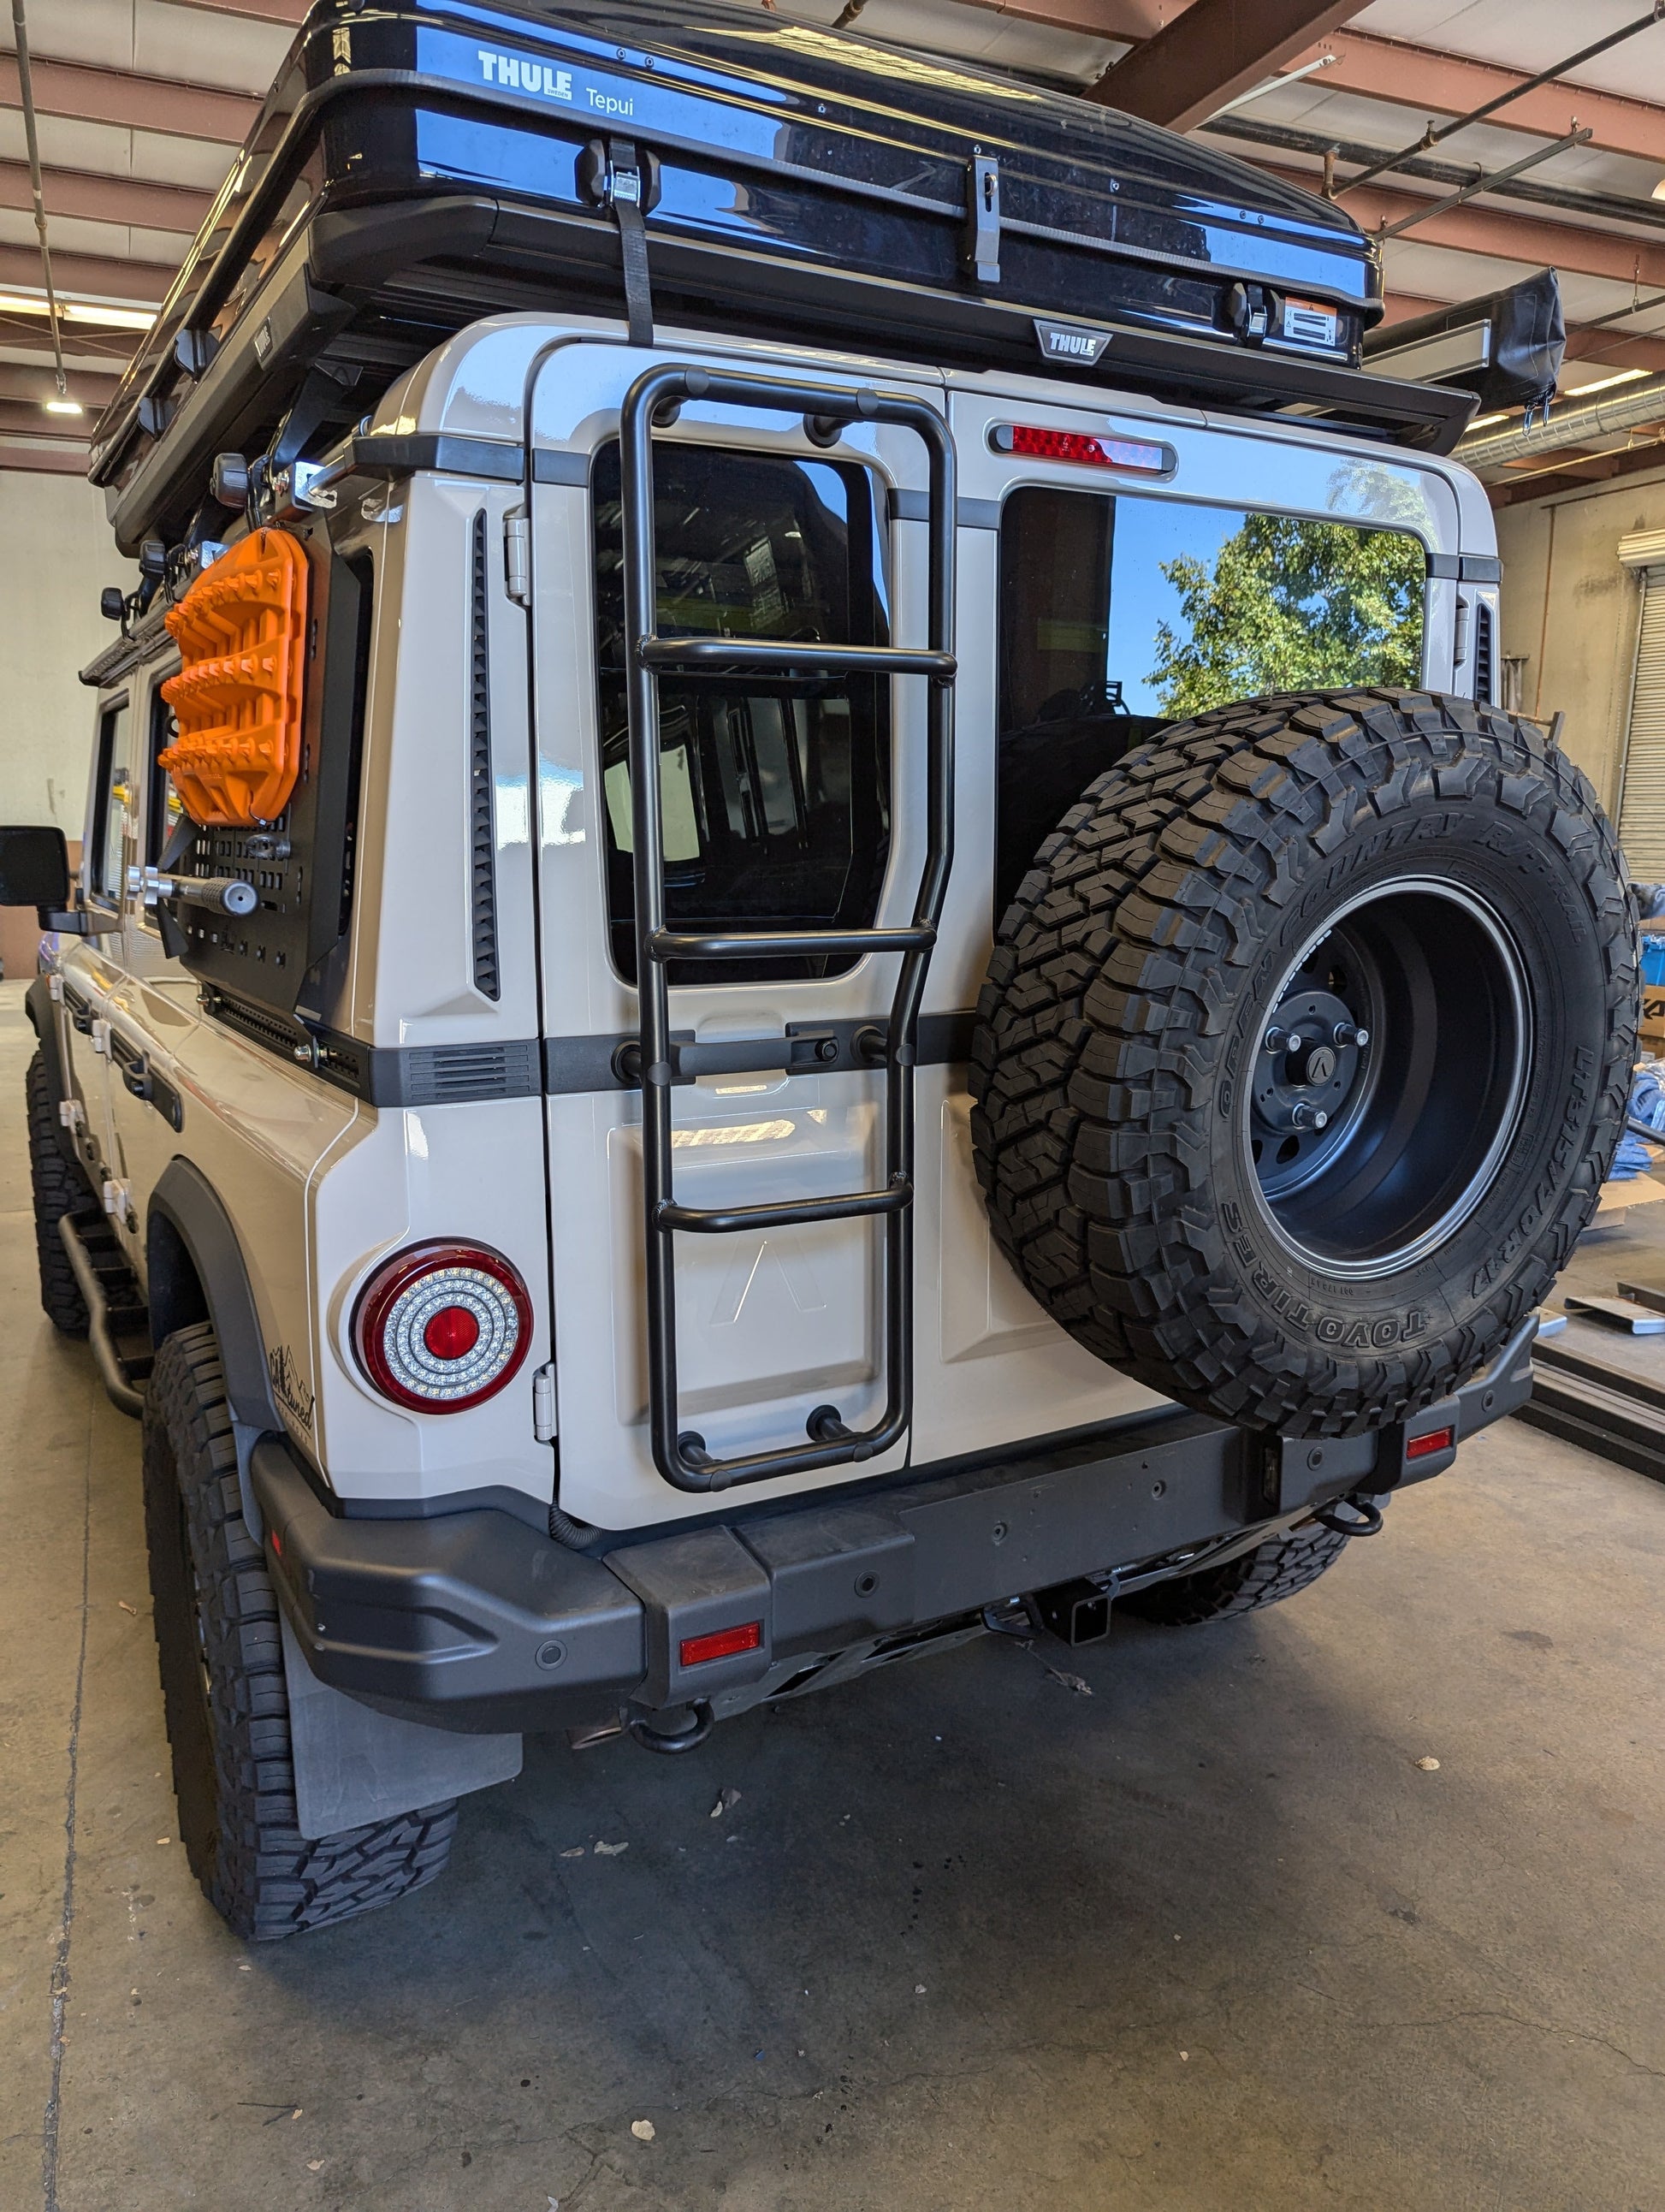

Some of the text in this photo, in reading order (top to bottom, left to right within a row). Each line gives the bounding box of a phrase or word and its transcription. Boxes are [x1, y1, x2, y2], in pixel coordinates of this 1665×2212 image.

[477, 50, 634, 116] THULE Tepui
[546, 87, 570, 98] SWEDEN
[1049, 331, 1098, 357] THULE
[1219, 950, 1278, 1118] OPEN
[1279, 811, 1477, 947] COUNTRY
[1221, 1201, 1427, 1349] TOYO TIRES
